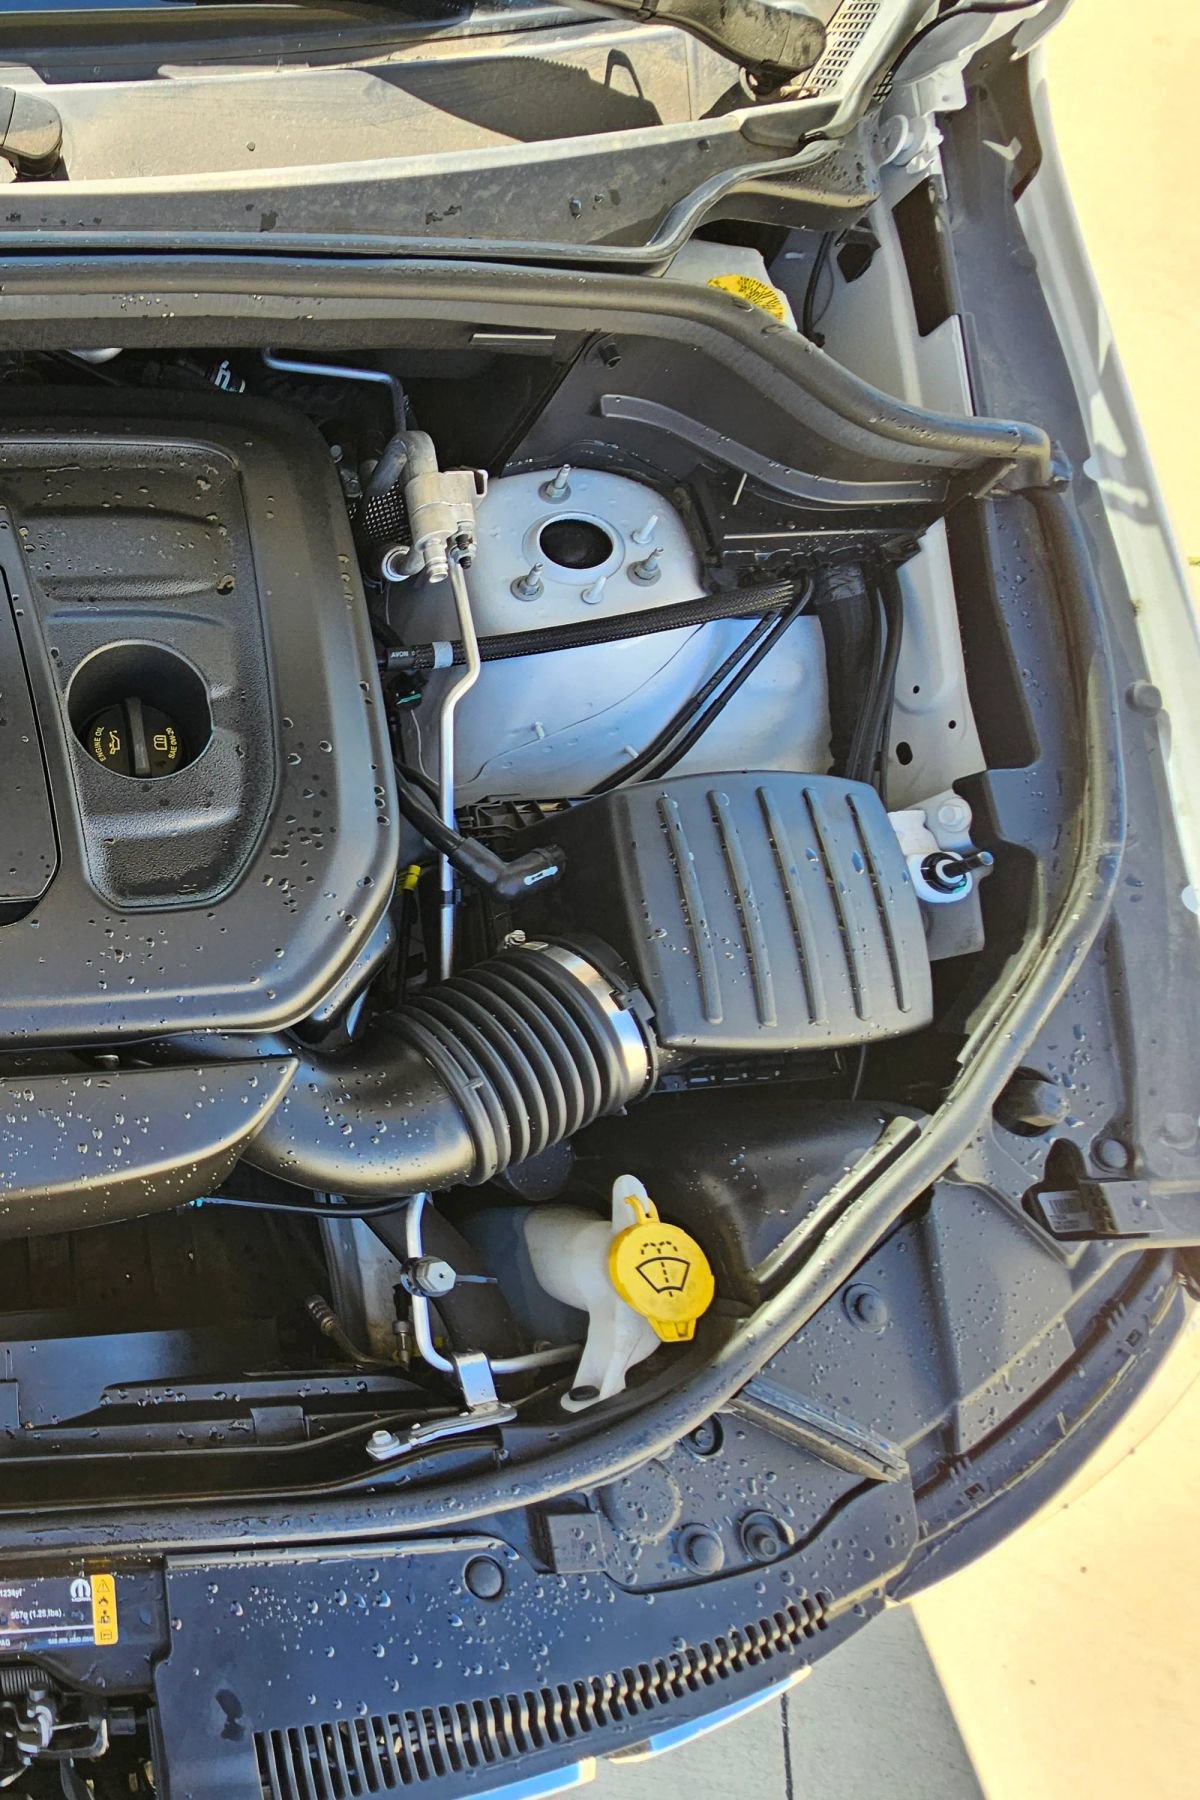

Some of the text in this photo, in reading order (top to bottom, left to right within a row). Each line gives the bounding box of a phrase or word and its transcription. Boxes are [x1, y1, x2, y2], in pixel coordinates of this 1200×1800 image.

[94, 726, 106, 761] ENGINE OIL
[168, 746, 177, 759] SAE
